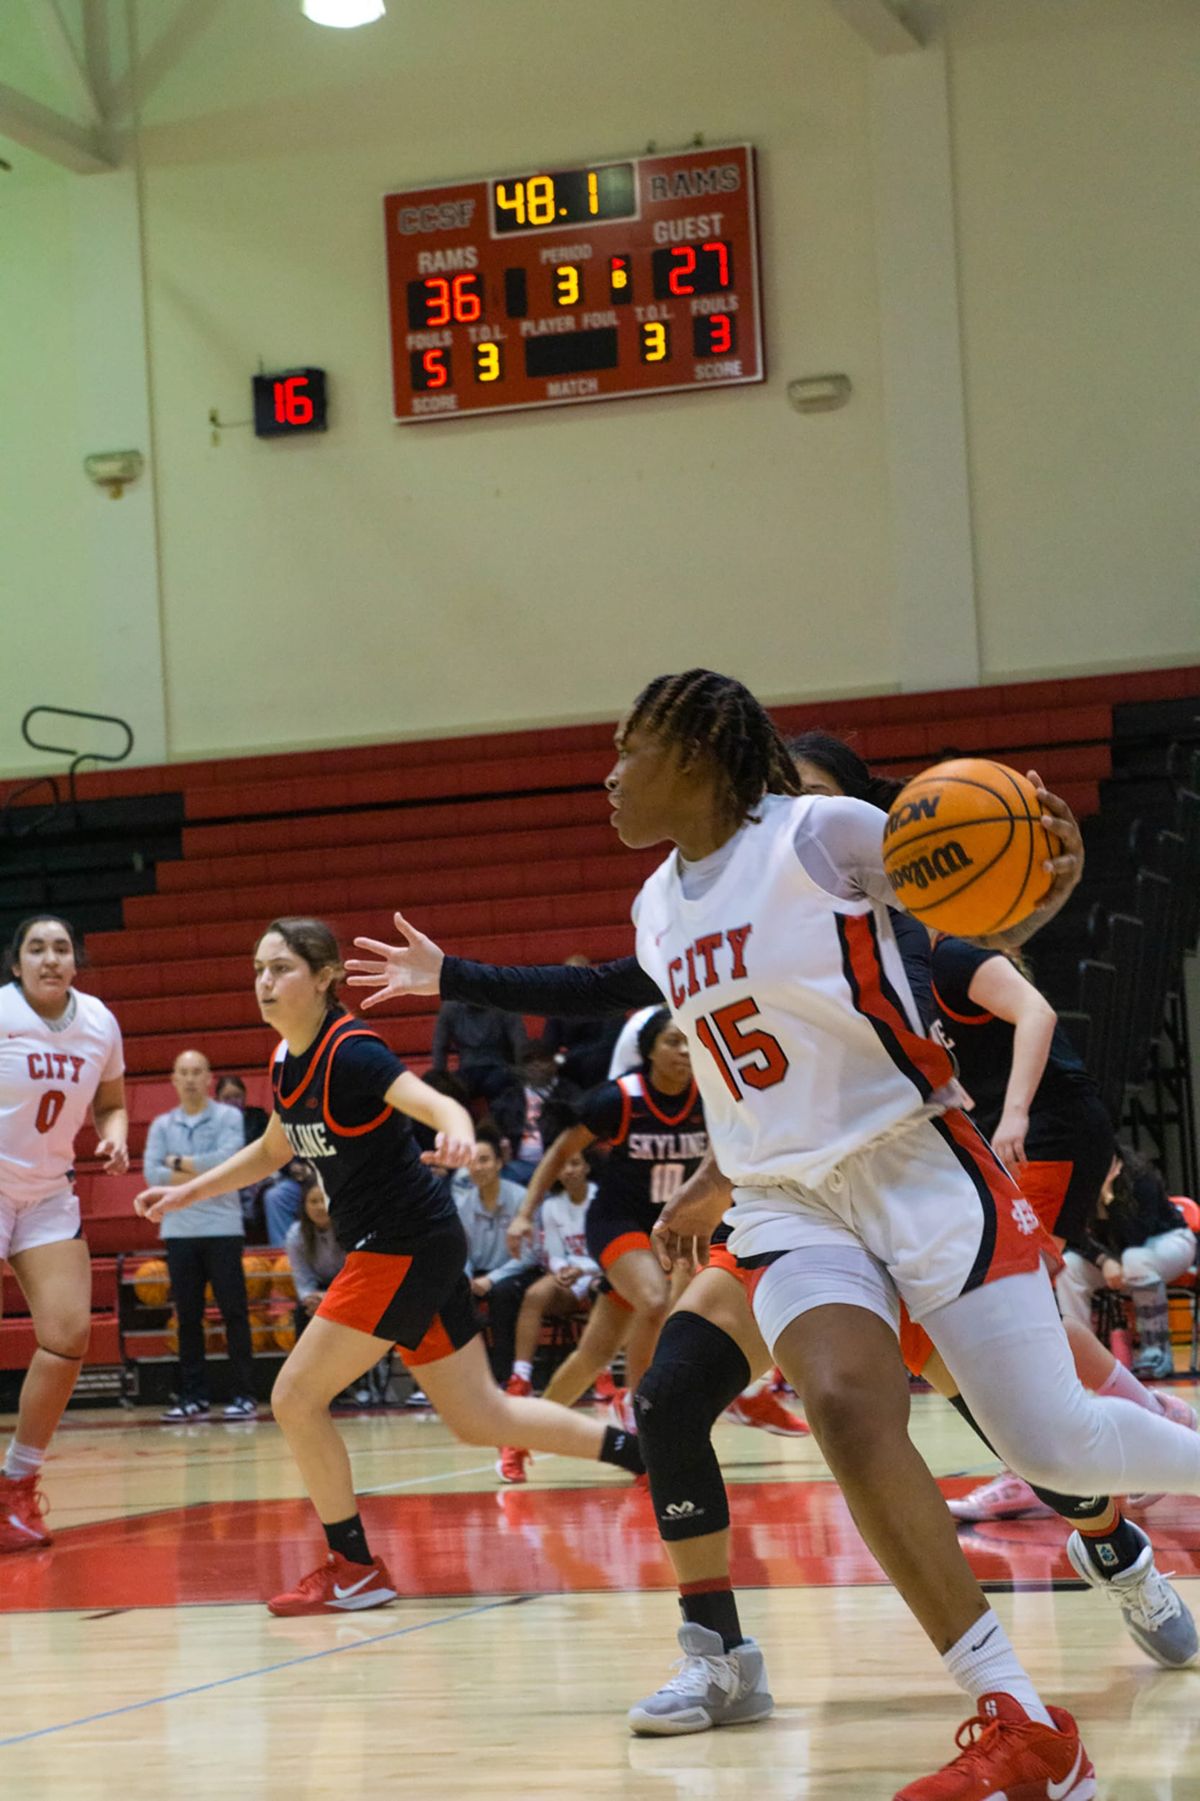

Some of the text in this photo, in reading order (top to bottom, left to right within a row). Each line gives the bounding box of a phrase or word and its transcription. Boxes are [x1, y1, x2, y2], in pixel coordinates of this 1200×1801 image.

[652, 166, 739, 200] RAMS
[399, 200, 474, 235] CCSF
[654, 214, 724, 243] GUEST
[419, 248, 477, 273] RAMS
[541, 245, 592, 264] PERIOD
[670, 243, 727, 294] 27
[426, 275, 480, 326] 36
[557, 266, 579, 305] 3
[691, 297, 739, 315] FOULS
[408, 331, 453, 349] FOULS
[521, 310, 618, 337] PLAYER FOUL
[710, 314, 731, 353] 3
[644, 322, 666, 361] 3
[423, 349, 447, 388] 5
[478, 343, 499, 381] 3
[696, 361, 742, 380] SCORE
[274, 377, 312, 424] 16
[413, 396, 458, 414] SCORE
[548, 379, 598, 398] MATCH
[667, 923, 753, 1010] CITY
[695, 996, 790, 1103] 15
[27, 1053, 86, 1084] CITY
[35, 1089, 66, 1135] 0
[628, 1131, 709, 1160] SKYLINE
